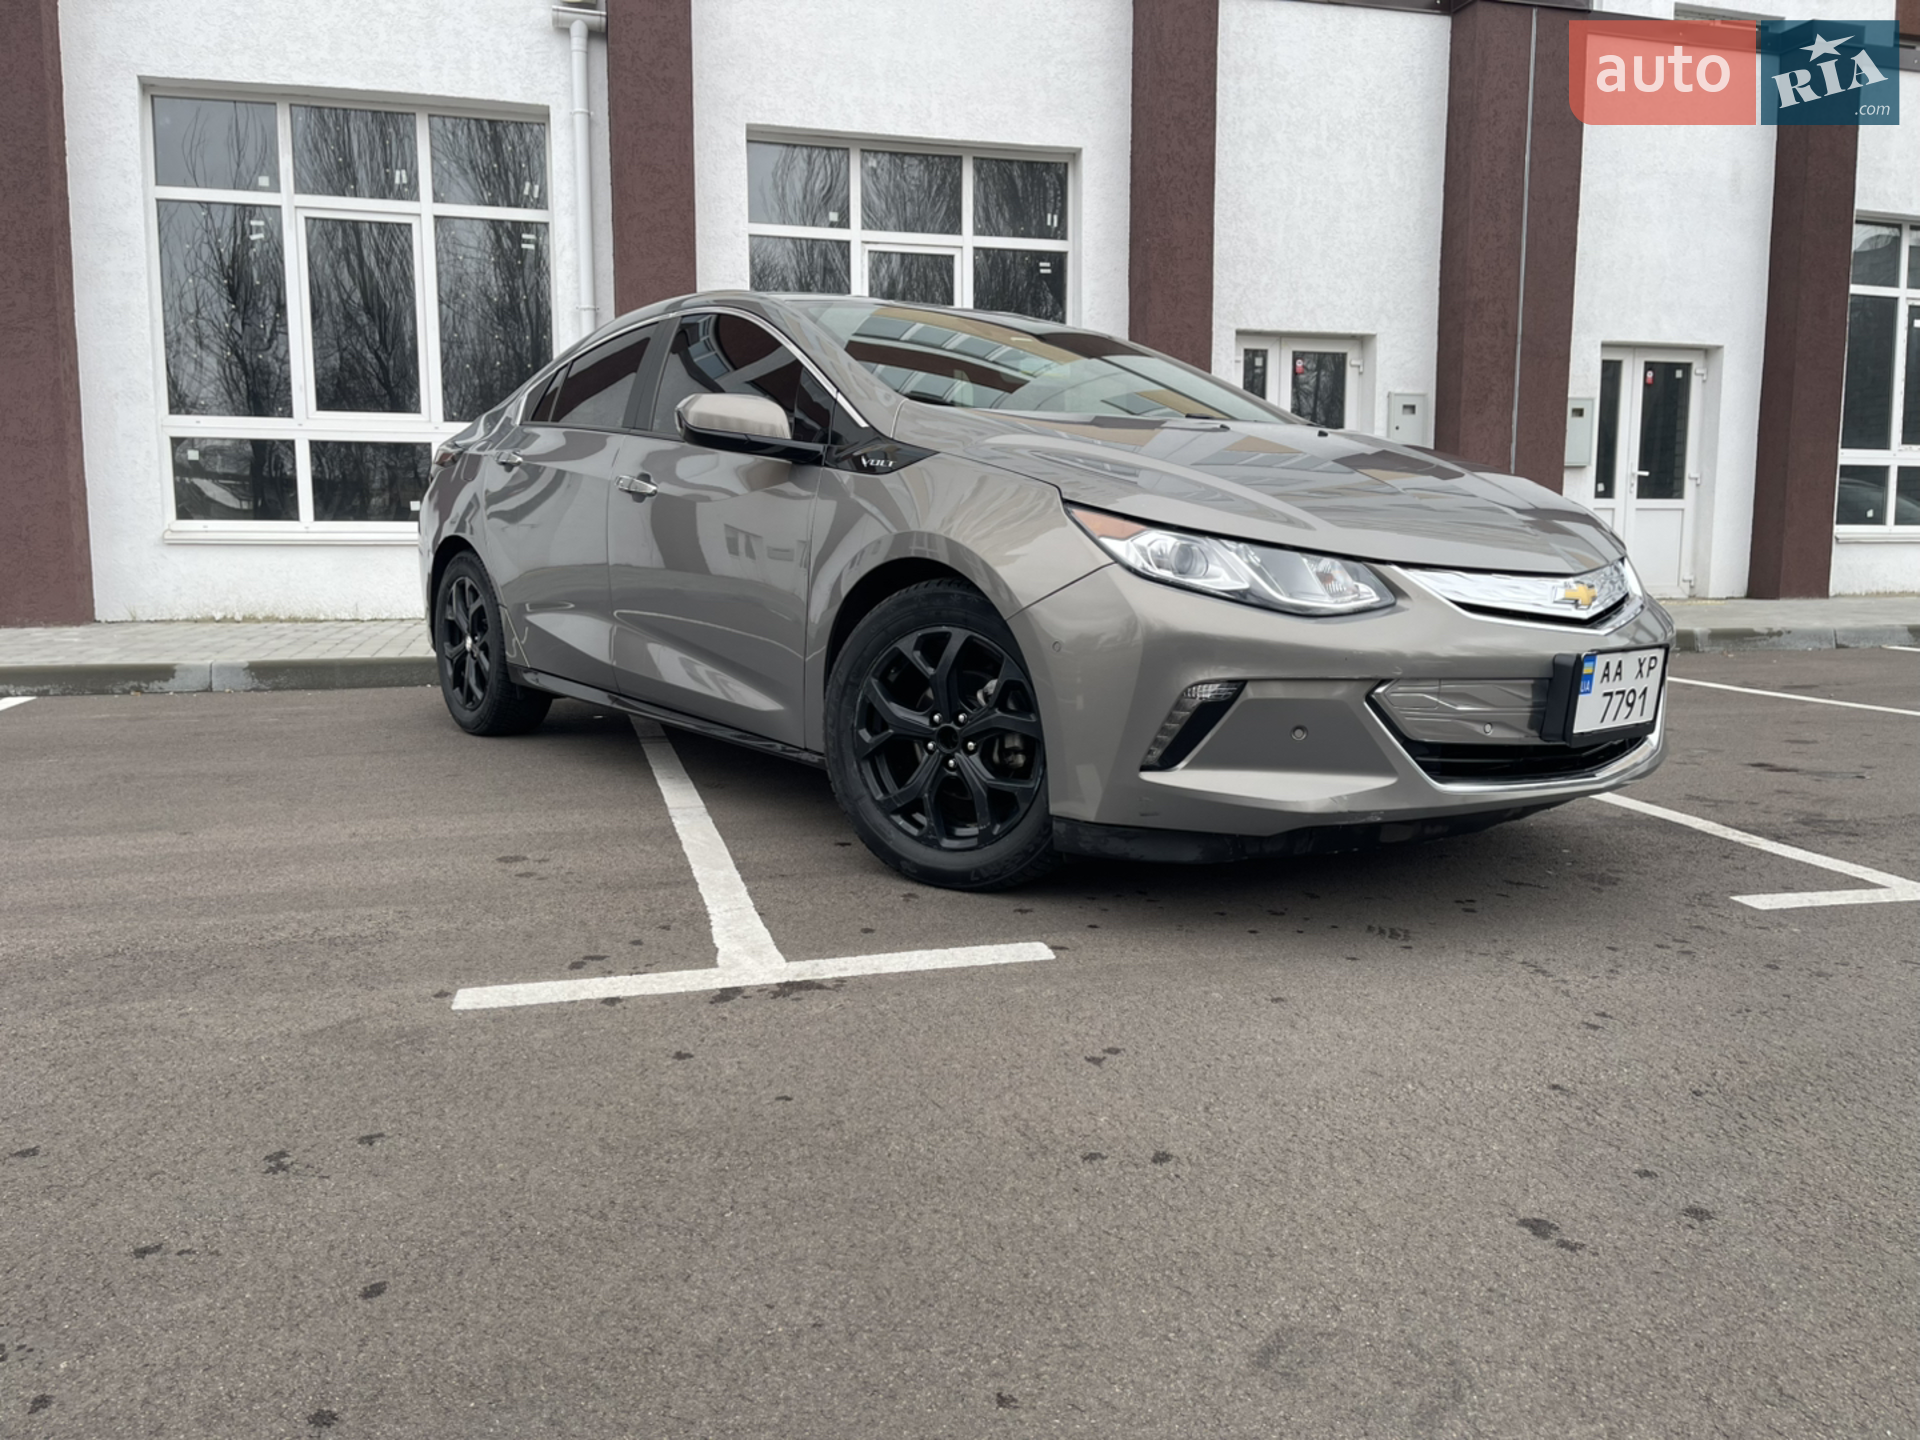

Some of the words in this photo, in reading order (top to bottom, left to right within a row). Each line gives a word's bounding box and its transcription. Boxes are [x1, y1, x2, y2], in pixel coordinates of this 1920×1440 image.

[861, 455, 895, 467] VOLT
[1600, 659, 1623, 684] AA
[1635, 656, 1659, 680] XP
[1600, 686, 1648, 724] 7791
